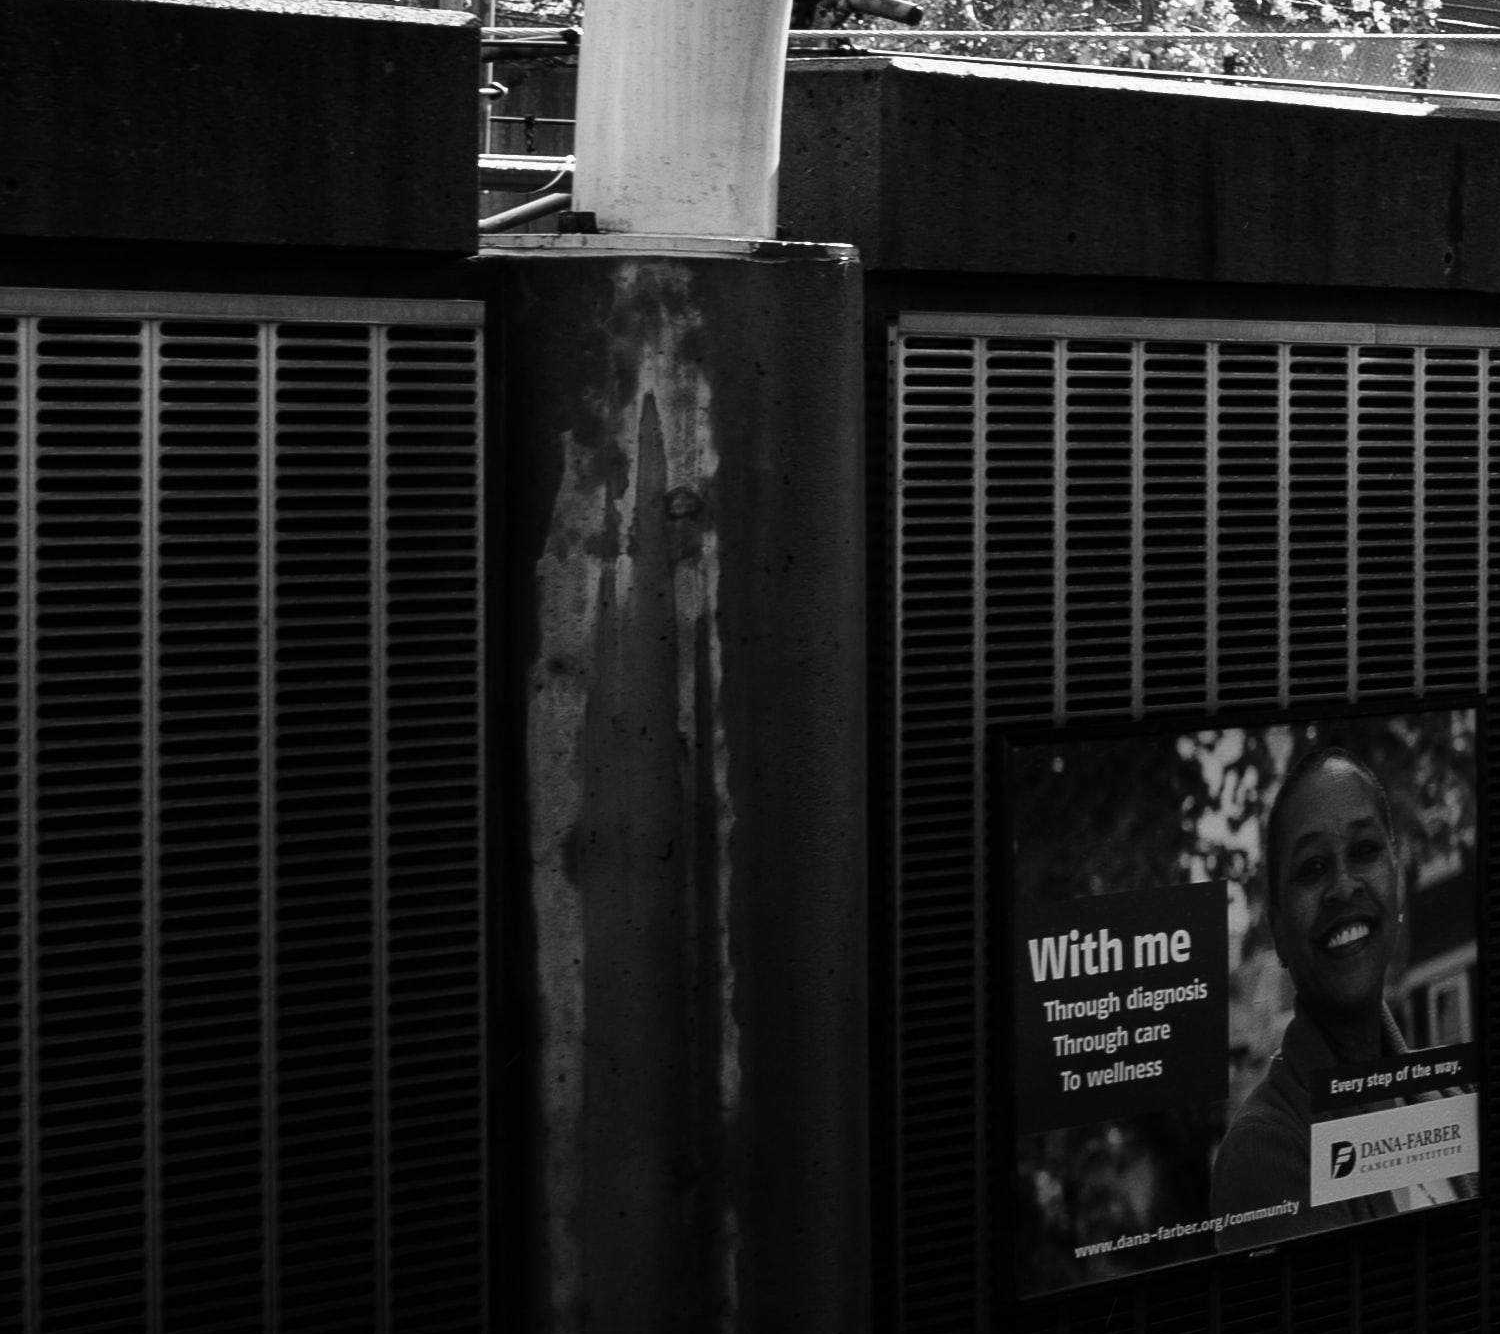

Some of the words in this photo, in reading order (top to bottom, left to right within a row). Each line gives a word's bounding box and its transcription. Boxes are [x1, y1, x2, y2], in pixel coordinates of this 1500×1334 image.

[1027, 928, 1124, 983] With
[1133, 929, 1192, 969] me
[1043, 991, 1121, 1022] Through
[1126, 977, 1208, 1012] diagnosis
[1052, 1025, 1129, 1057] Through
[1134, 1022, 1172, 1044] care
[1060, 1070, 1081, 1092] To
[1086, 1059, 1163, 1088] wellness
[1330, 1076, 1364, 1095] Every
[1366, 1072, 1392, 1088] step
[1395, 1065, 1410, 1082] of
[1412, 1063, 1432, 1079] the
[1434, 1060, 1462, 1075] way.
[1360, 1123, 1462, 1159] DANA-FARBER
[1074, 1198, 1300, 1259] www.dana-farber.org/community
